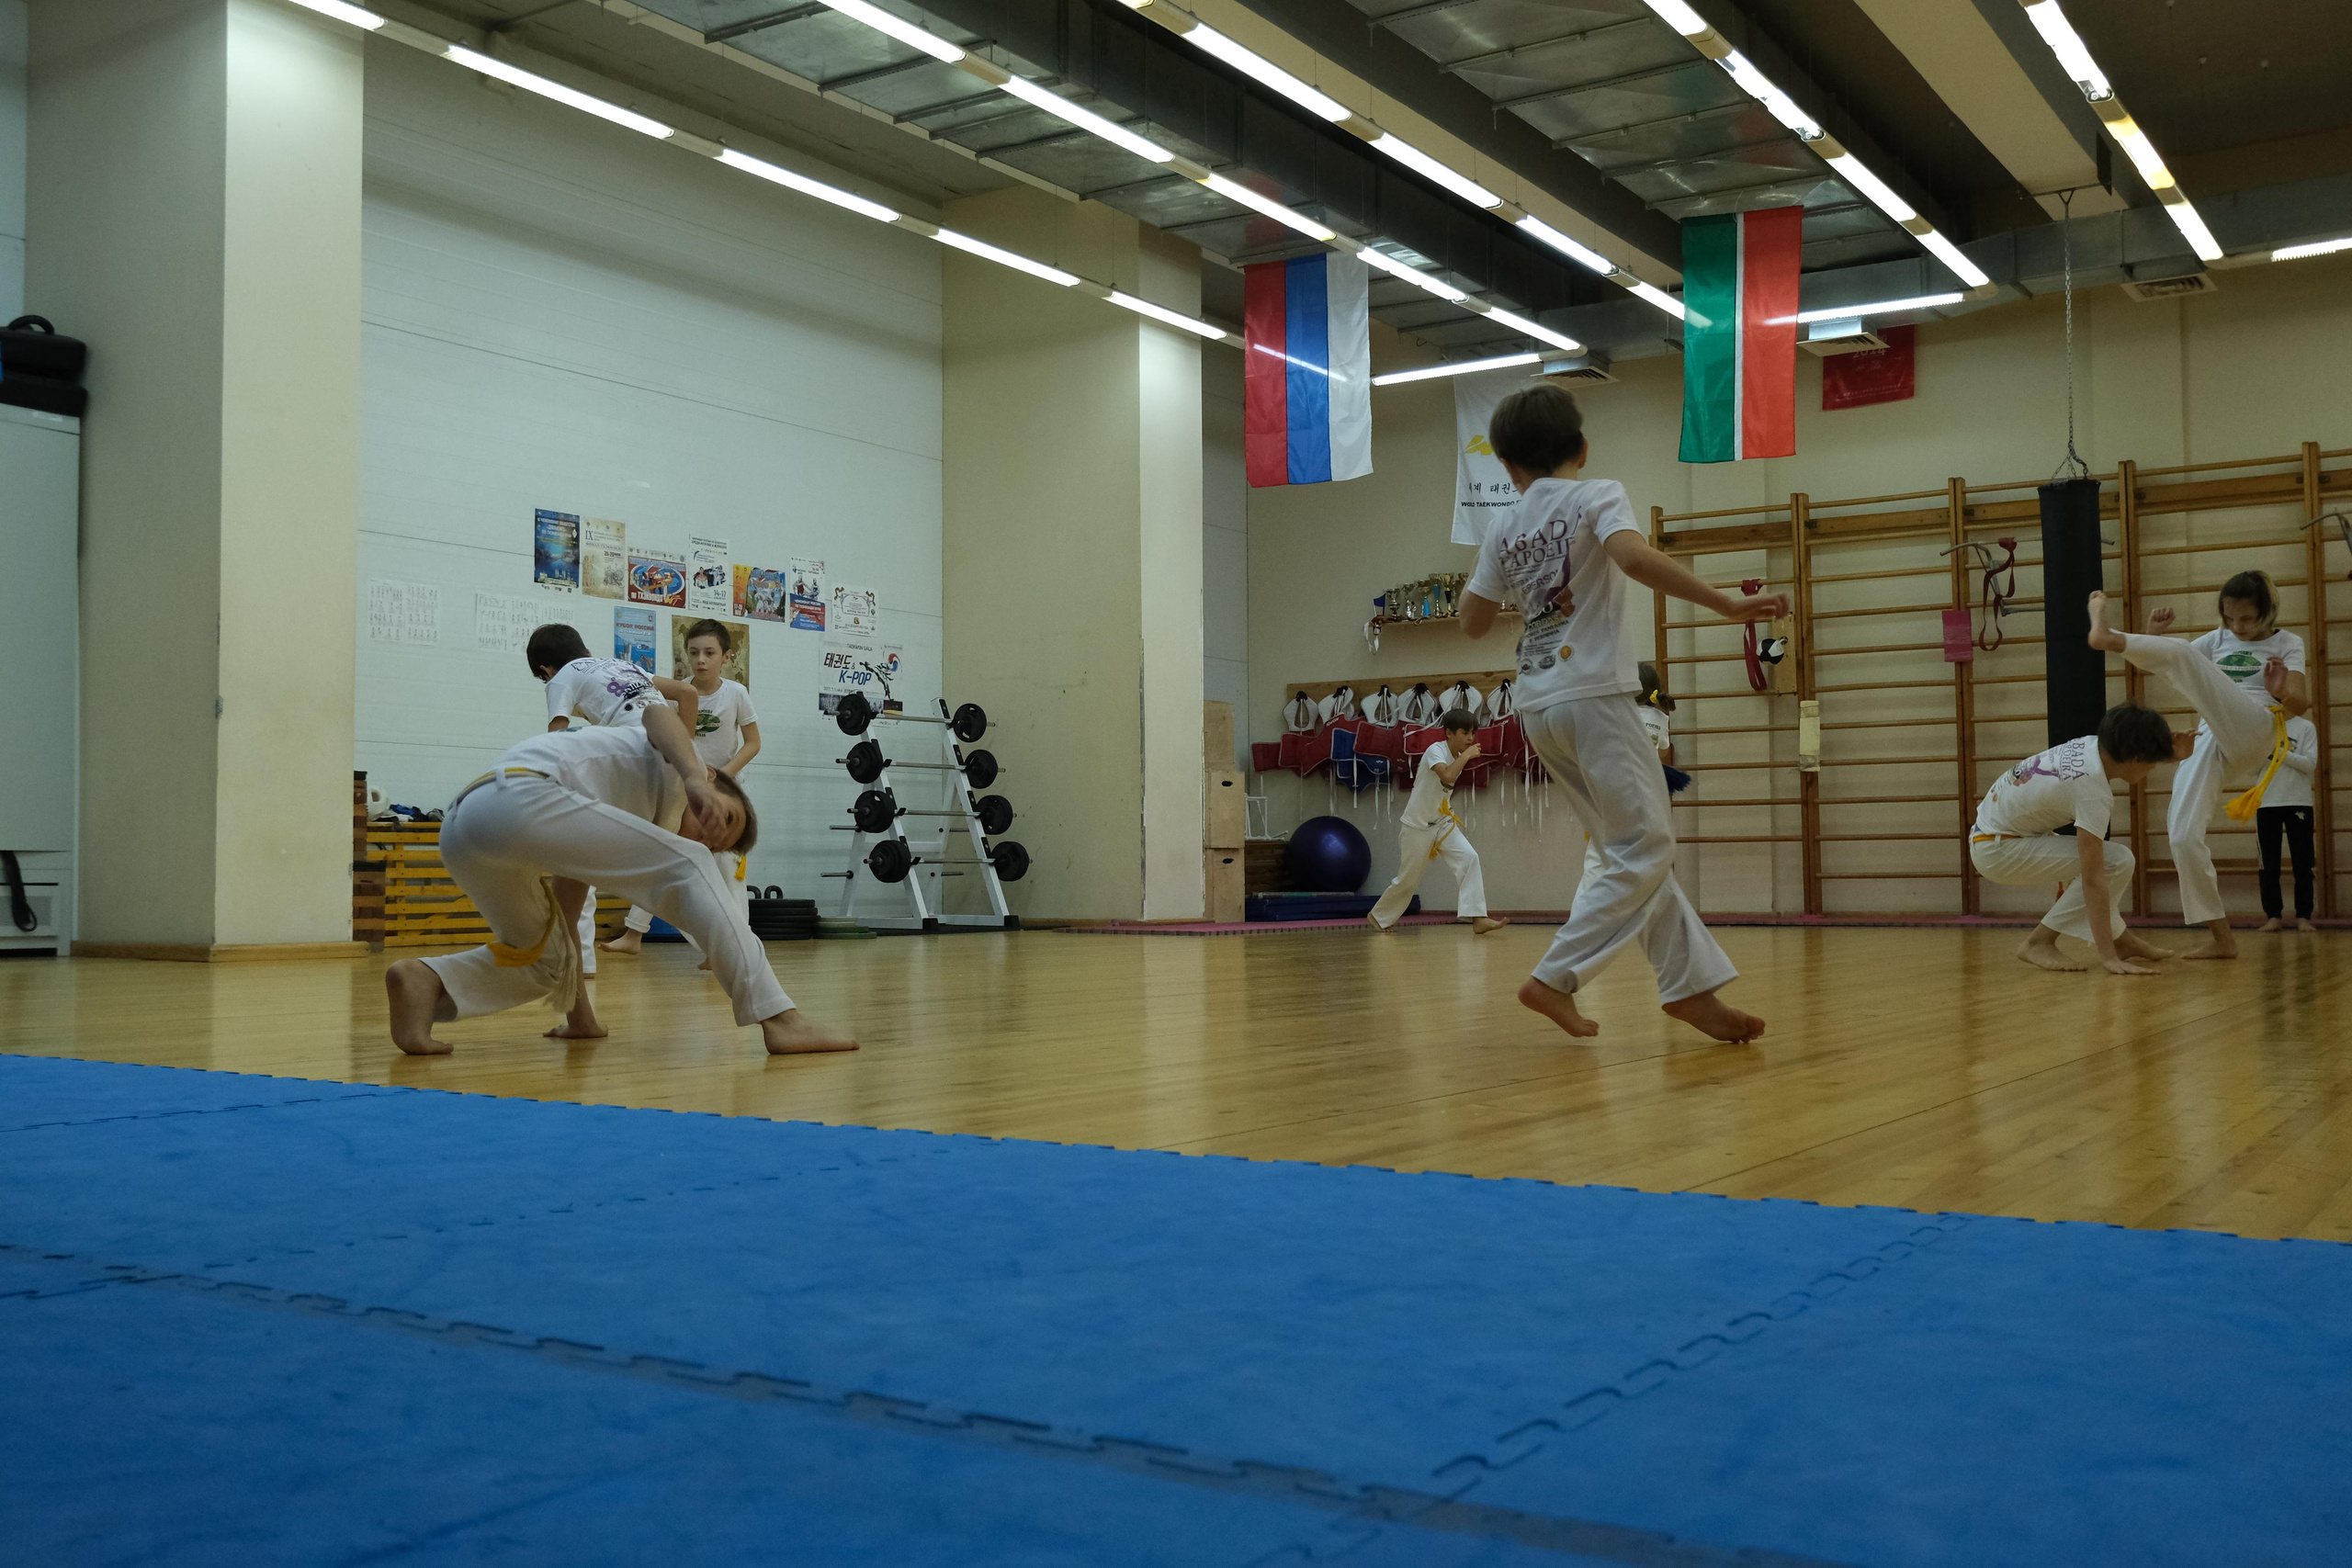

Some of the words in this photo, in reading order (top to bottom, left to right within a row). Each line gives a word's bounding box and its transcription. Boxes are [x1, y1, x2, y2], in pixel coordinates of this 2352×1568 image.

[1489, 482, 1518, 495] 태권
[585, 530, 594, 540] IX
[713, 589, 727, 597] 14-17
[823, 652, 853, 671] 태권도
[838, 670, 872, 686] K-POP
[2071, 740, 2089, 781] BADÁ
